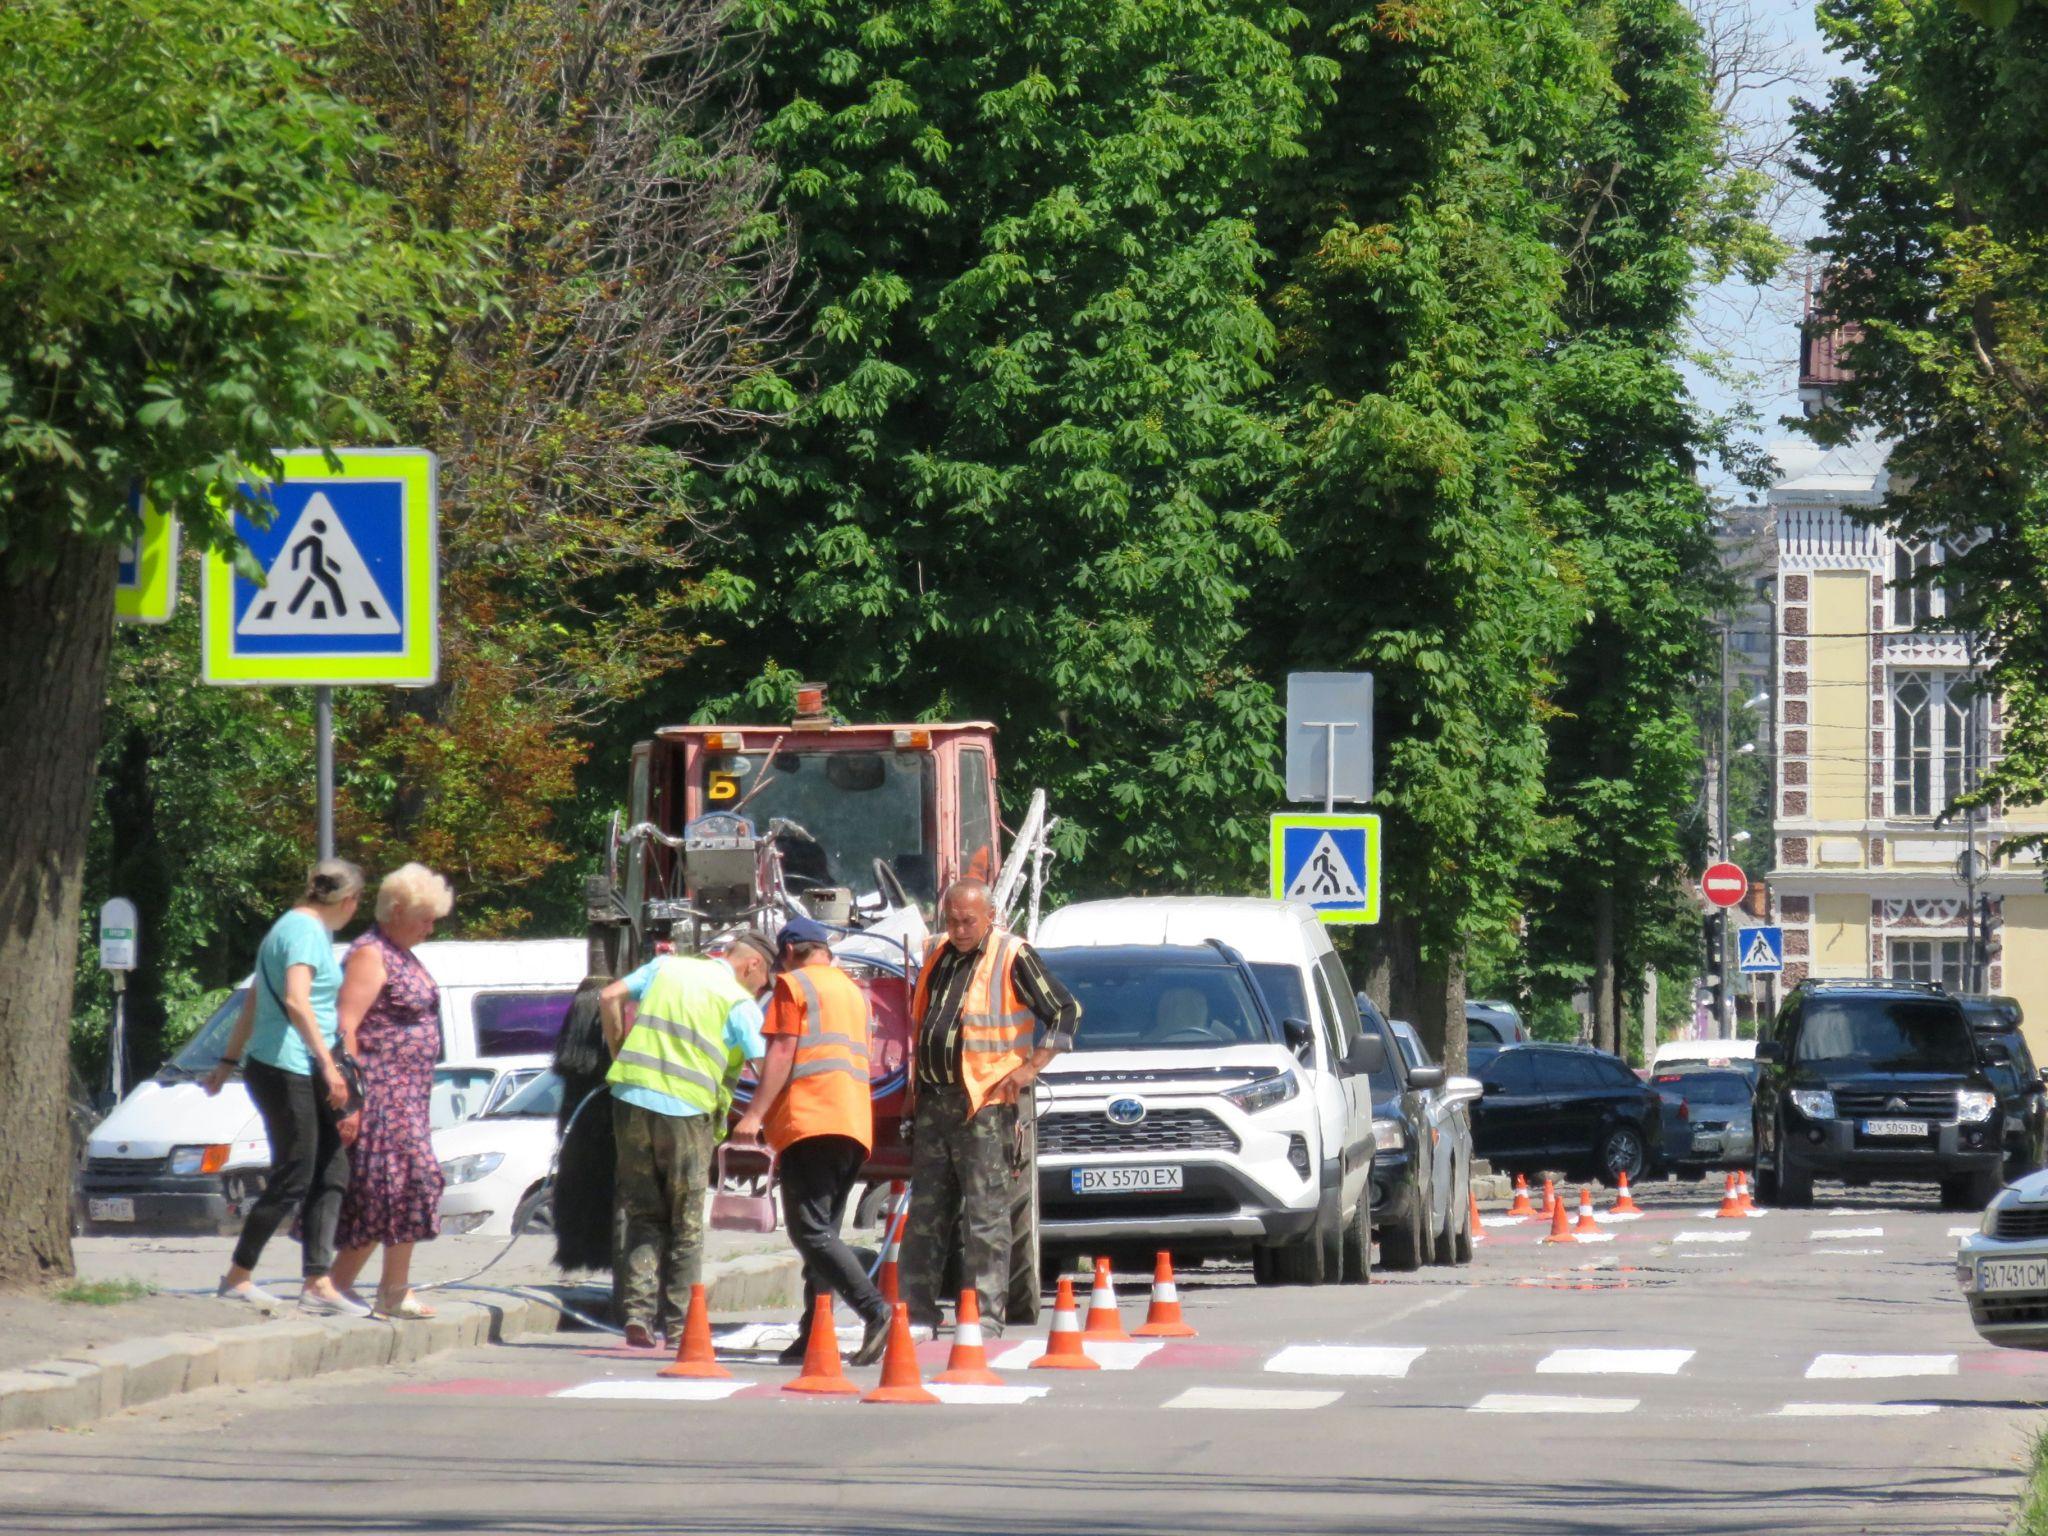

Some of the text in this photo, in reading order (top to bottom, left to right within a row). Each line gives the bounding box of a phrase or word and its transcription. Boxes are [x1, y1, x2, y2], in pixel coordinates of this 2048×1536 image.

[709, 770, 736, 799] Б
[1083, 1168, 1178, 1188] BX 5570 EX
[2000, 1264, 2025, 1287] 7431
[2028, 1264, 2046, 1287] CM
